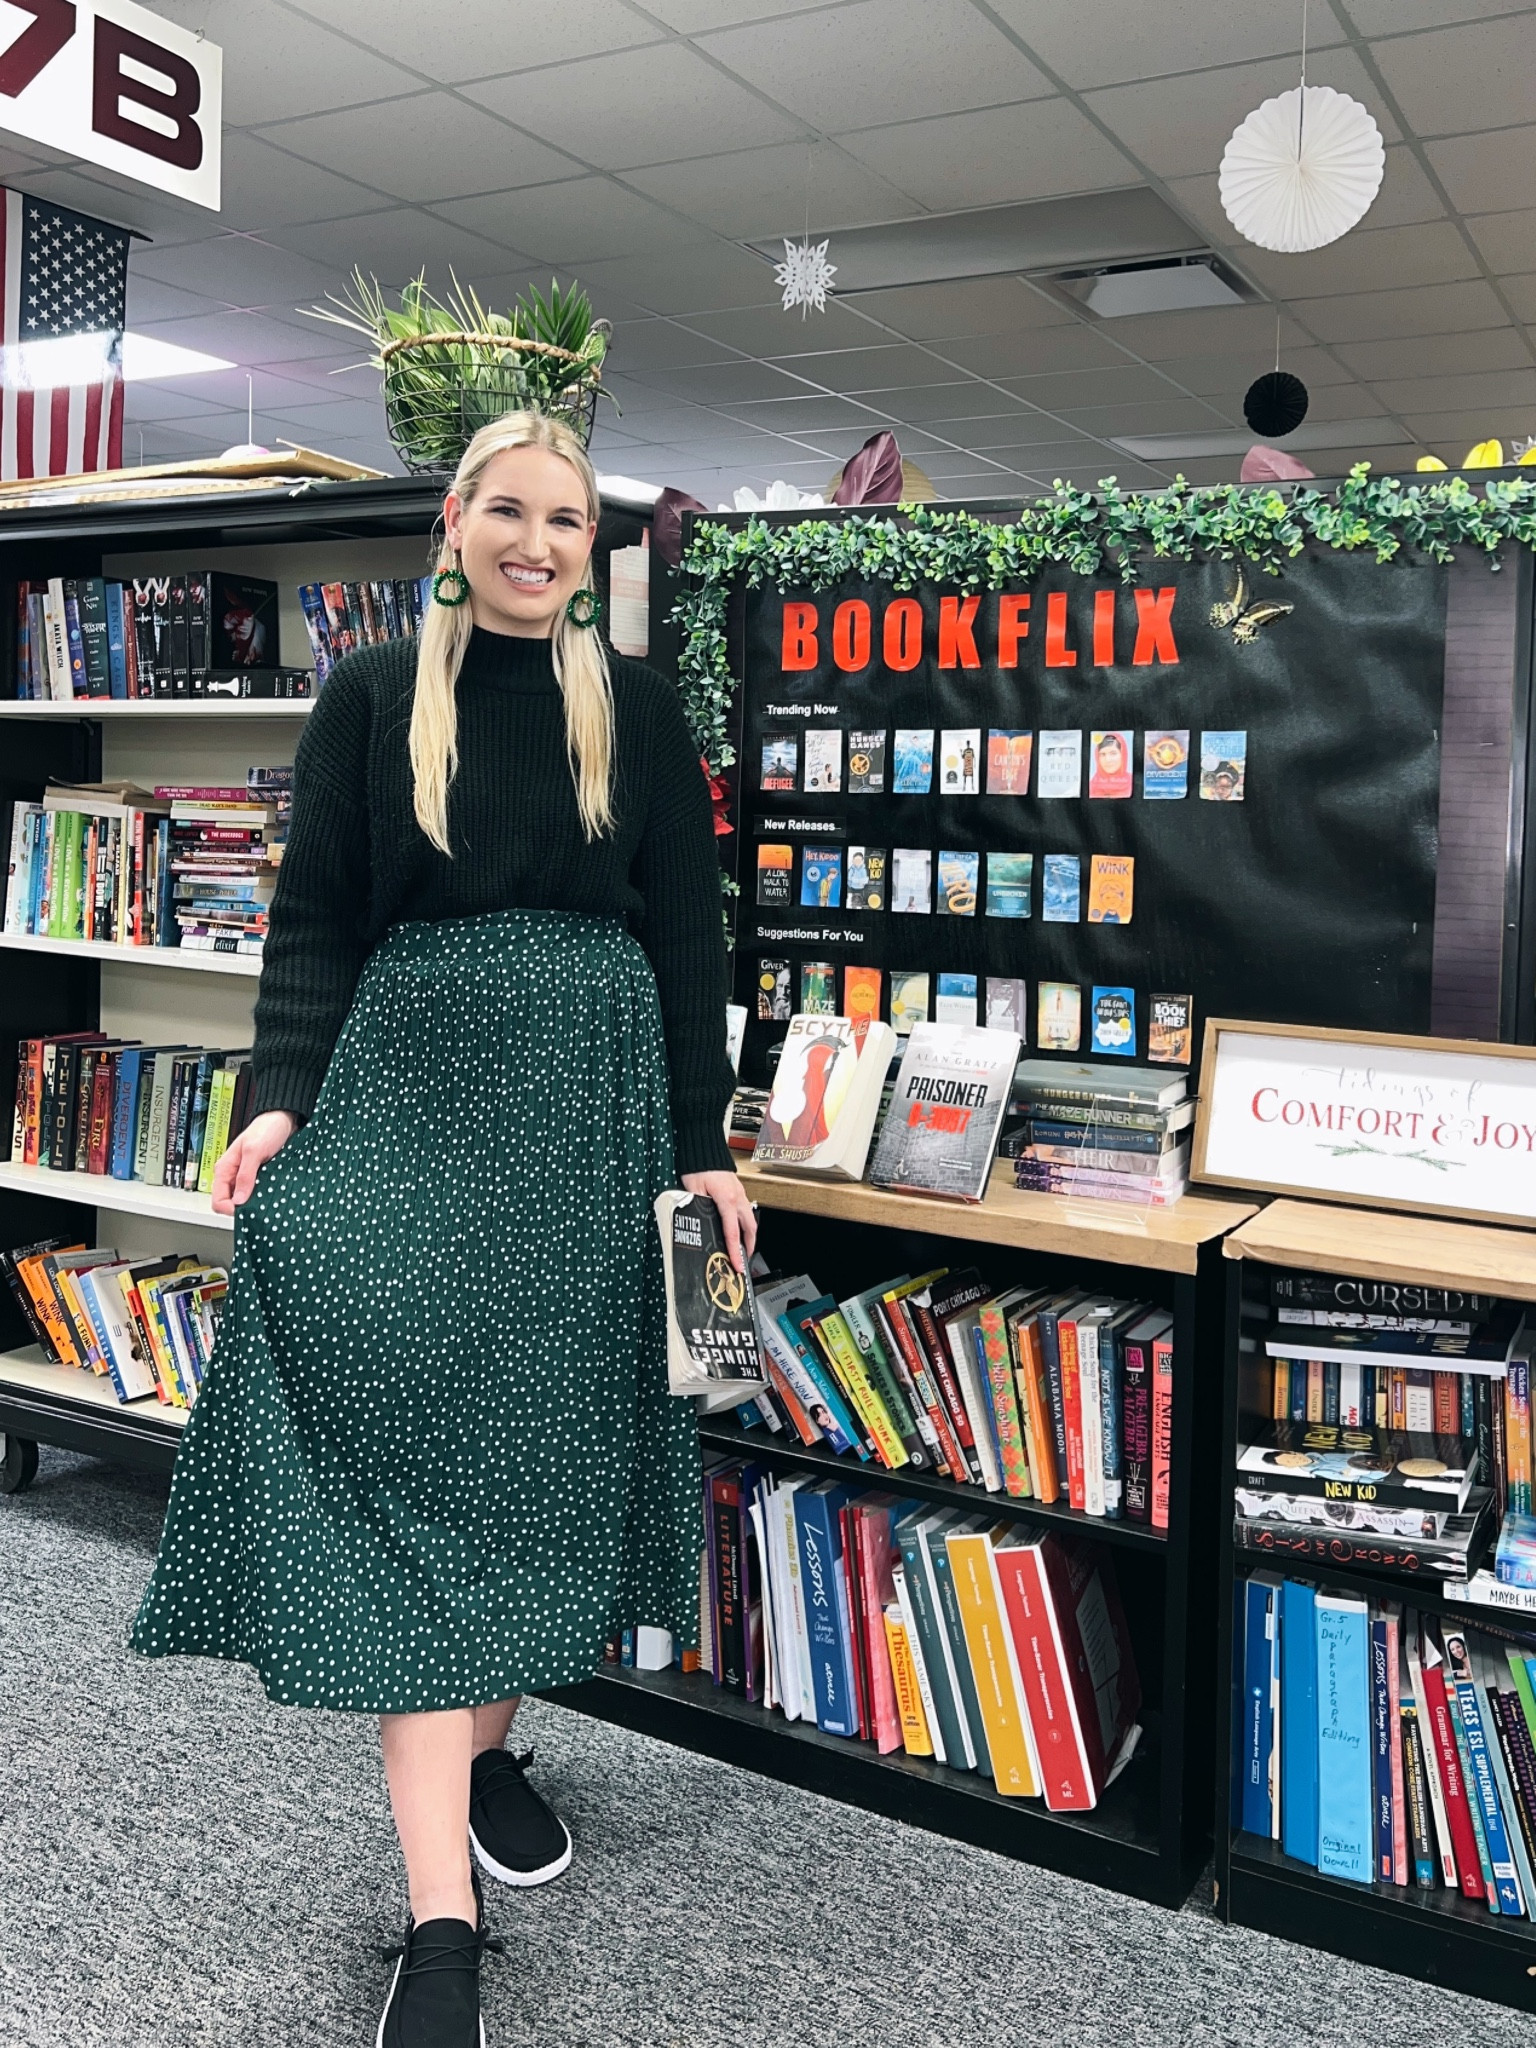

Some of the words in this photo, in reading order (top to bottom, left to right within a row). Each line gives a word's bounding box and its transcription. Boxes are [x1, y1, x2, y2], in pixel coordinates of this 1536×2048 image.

[0, 0, 204, 171] 7B
[54, 624, 62, 644] AKATA
[781, 587, 1181, 672] BOOKFLIX
[56, 646, 64, 668] WITCH
[766, 704, 812, 717] Trending
[813, 704, 839, 715] Now
[764, 819, 786, 829] New
[788, 819, 835, 831] Releases
[1096, 861, 1129, 875] WINK
[50, 878, 59, 921] REVOLUTION
[62, 879, 70, 922] REVOLUTION
[95, 883, 104, 907] DOWN
[765, 888, 788, 897] WATER
[215, 940, 236, 951] elixir
[757, 926, 820, 939] Suggestions
[822, 929, 841, 941] For
[843, 930, 864, 942] You
[760, 960, 784, 970] GIVER
[803, 1000, 835, 1012] MAZE
[1154, 1003, 1187, 1016] BOOK
[790, 1019, 870, 1037] SCYTHE
[1156, 1014, 1187, 1027] THIEF
[59, 1054, 70, 1095] THE
[916, 1053, 951, 1064] ALAN
[954, 1057, 998, 1070] GRATZ
[906, 1076, 989, 1109] PRISONER
[1302, 1067, 1434, 1107] tidings
[1449, 1079, 1483, 1112] of
[117, 1081, 131, 1160] DIVERGENT
[150, 1085, 164, 1163] INSURGENT
[167, 1096, 178, 1131] SCORCH
[176, 1098, 188, 1127] DEATH
[208, 1100, 218, 1120] MAZE
[1048, 1105, 1083, 1119] MAZE
[1083, 1108, 1132, 1125] RUNNER
[1251, 1087, 1424, 1139] COMFORT
[1431, 1114, 1476, 1147] &
[1473, 1115, 1536, 1152] JOY
[55, 1102, 66, 1158] TOLL
[138, 1093, 150, 1165] INSURGENT
[176, 1128, 185, 1154] CURE
[205, 1122, 215, 1150] RUNNER
[167, 1132, 176, 1161] TRIALS
[753, 1148, 776, 1159] NEAL
[674, 1213, 701, 1232] COLLINS
[674, 1229, 702, 1247] SUZANNE
[46, 1266, 58, 1280] LOIS
[51, 1280, 66, 1300] LOWRY
[933, 1300, 953, 1317] PORT
[950, 1285, 981, 1309] CHICAGO
[1334, 1281, 1464, 1313] CURSED
[34, 1296, 54, 1323] WINK
[47, 1299, 68, 1326] WINK
[844, 1303, 862, 1330] FOWLER
[691, 1328, 755, 1348] GAMES
[917, 1307, 936, 1345] SHEINKIN
[691, 1346, 759, 1366] HUNGER
[896, 1325, 916, 1361] Strategies
[1080, 1332, 1088, 1360] Teenage
[1089, 1333, 1097, 1359] Chicken
[741, 1367, 758, 1378] THE
[768, 1344, 781, 1357] AM
[777, 1357, 796, 1381] HERE
[791, 1379, 813, 1402] NOW
[1089, 1361, 1097, 1378] Soup
[1102, 1370, 1110, 1390] NOT
[1508, 1367, 1517, 1395] Teenage
[1518, 1368, 1526, 1396] Chicken
[841, 1352, 863, 1384] FIRST
[857, 1384, 876, 1411] RULE
[872, 1416, 892, 1445] PUNK
[865, 1352, 889, 1389] SNAKES
[884, 1394, 908, 1432] STONES
[933, 1355, 948, 1379] PORT
[941, 1378, 961, 1413] CHICAGO
[954, 1414, 965, 1427] 50
[1103, 1392, 1110, 1404] AS
[995, 1396, 1011, 1443] Sunshine
[1049, 1365, 1061, 1419] ALABAMA
[1055, 1424, 1065, 1454] MOON
[1103, 1408, 1111, 1427] WE
[1518, 1397, 1526, 1414] Soup
[1124, 1392, 1136, 1453] ALGEBRA
[1135, 1388, 1147, 1463] PRE-ALGEBRA
[1161, 1391, 1171, 1460] ENGLISH
[937, 1428, 956, 1462] McGraw
[1103, 1429, 1112, 1461] KNOW
[1104, 1464, 1113, 1477] IT
[1248, 1476, 1266, 1486] CRAFT
[1325, 1482, 1352, 1499] NEW
[1278, 1501, 1325, 1517] QUEEN'S
[1356, 1513, 1409, 1527] ASSASSIN
[785, 1514, 797, 1560] Phonics
[1254, 1531, 1312, 1553] SIX
[1329, 1539, 1421, 1570] CROWS
[720, 1515, 733, 1626] LITERATURE
[730, 1545, 738, 1577] McDougal
[803, 1522, 829, 1607] Lessons
[1489, 1589, 1521, 1605] MAYBE
[1321, 1629, 1351, 1645] Daily
[891, 1628, 910, 1713] Thesaurus
[909, 1634, 919, 1658] THIS
[914, 1660, 925, 1688] SAME
[922, 1690, 933, 1710] SKY
[1373, 1641, 1388, 1684] Lessons
[1031, 1637, 1044, 1671] Time-Saver
[1039, 1672, 1054, 1720] Transparencies
[1321, 1728, 1360, 1749] Editing
[1435, 1706, 1448, 1746] Grammar
[1470, 1731, 1481, 1750] ESL
[1443, 1749, 1452, 1761] for
[1410, 1724, 1419, 1762] NAVIGATING
[1417, 1802, 1426, 1835] LANGUAGE
[1429, 1771, 1438, 1799] APPROACH
[1444, 1764, 1460, 1796] Writing
[1450, 1703, 1459, 1719] CRUZ
[1458, 1749, 1473, 1797] UNSTOPPABLE
[1469, 1801, 1479, 1831] WRITING
[1476, 1835, 1487, 1866] TEACHER
[1475, 1754, 1498, 1816] SUPPLEMENTAL
[1323, 1836, 1361, 1853] Original
